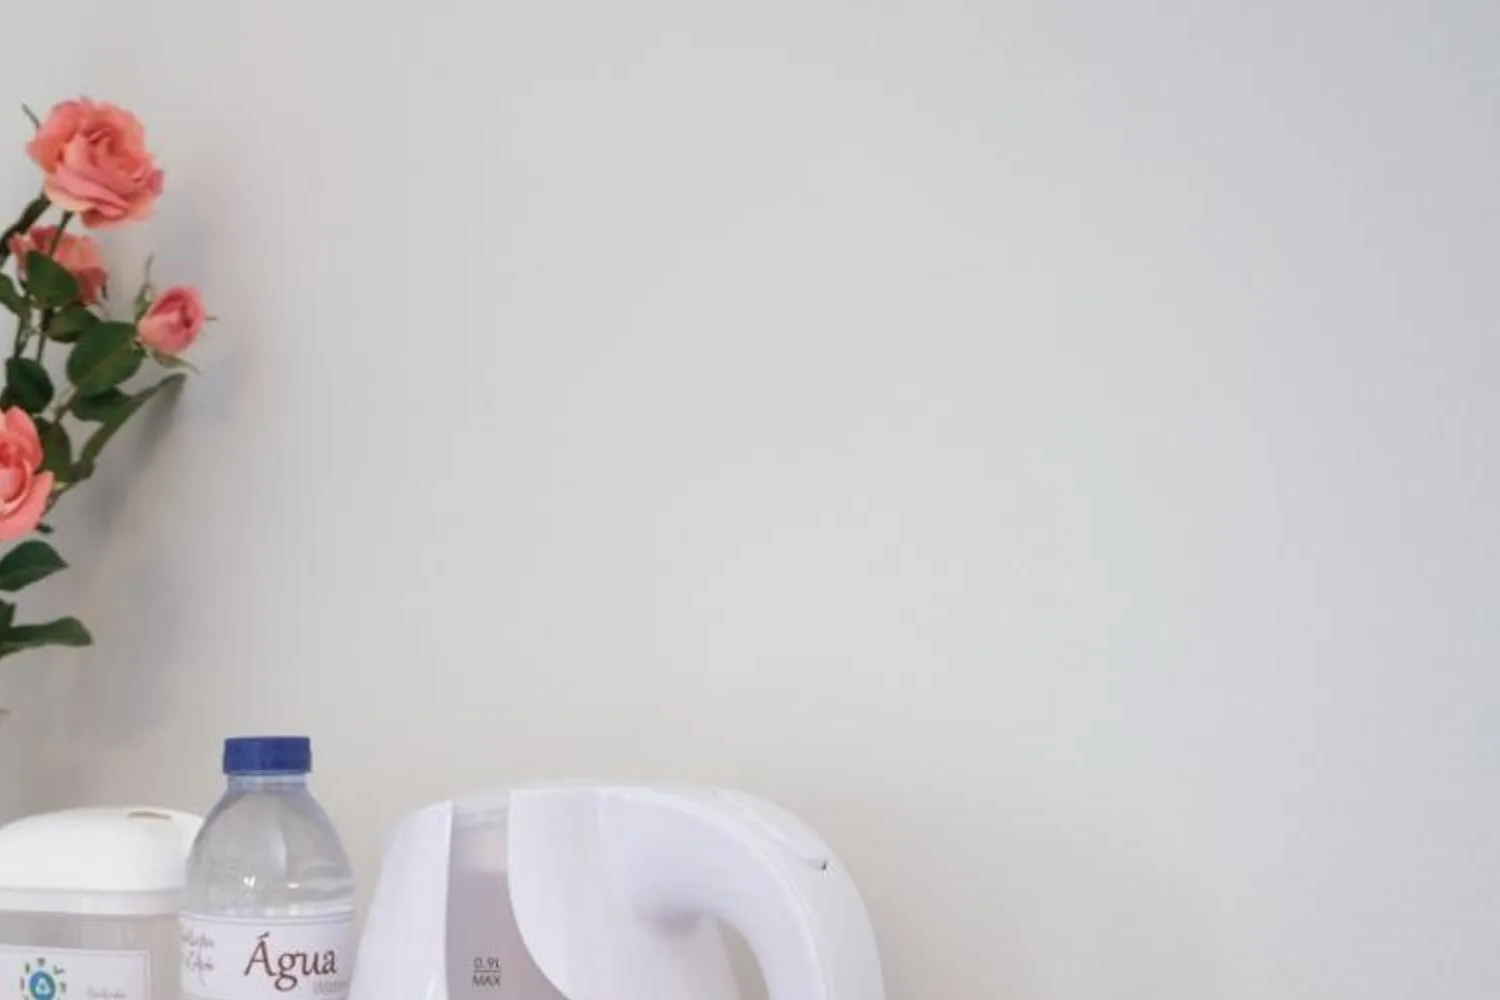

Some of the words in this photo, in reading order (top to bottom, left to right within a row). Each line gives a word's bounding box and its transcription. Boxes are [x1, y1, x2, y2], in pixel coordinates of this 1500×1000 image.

[244, 931, 337, 993] Água
[473, 956, 501, 969] 0.9L
[472, 974, 501, 987] MAX
